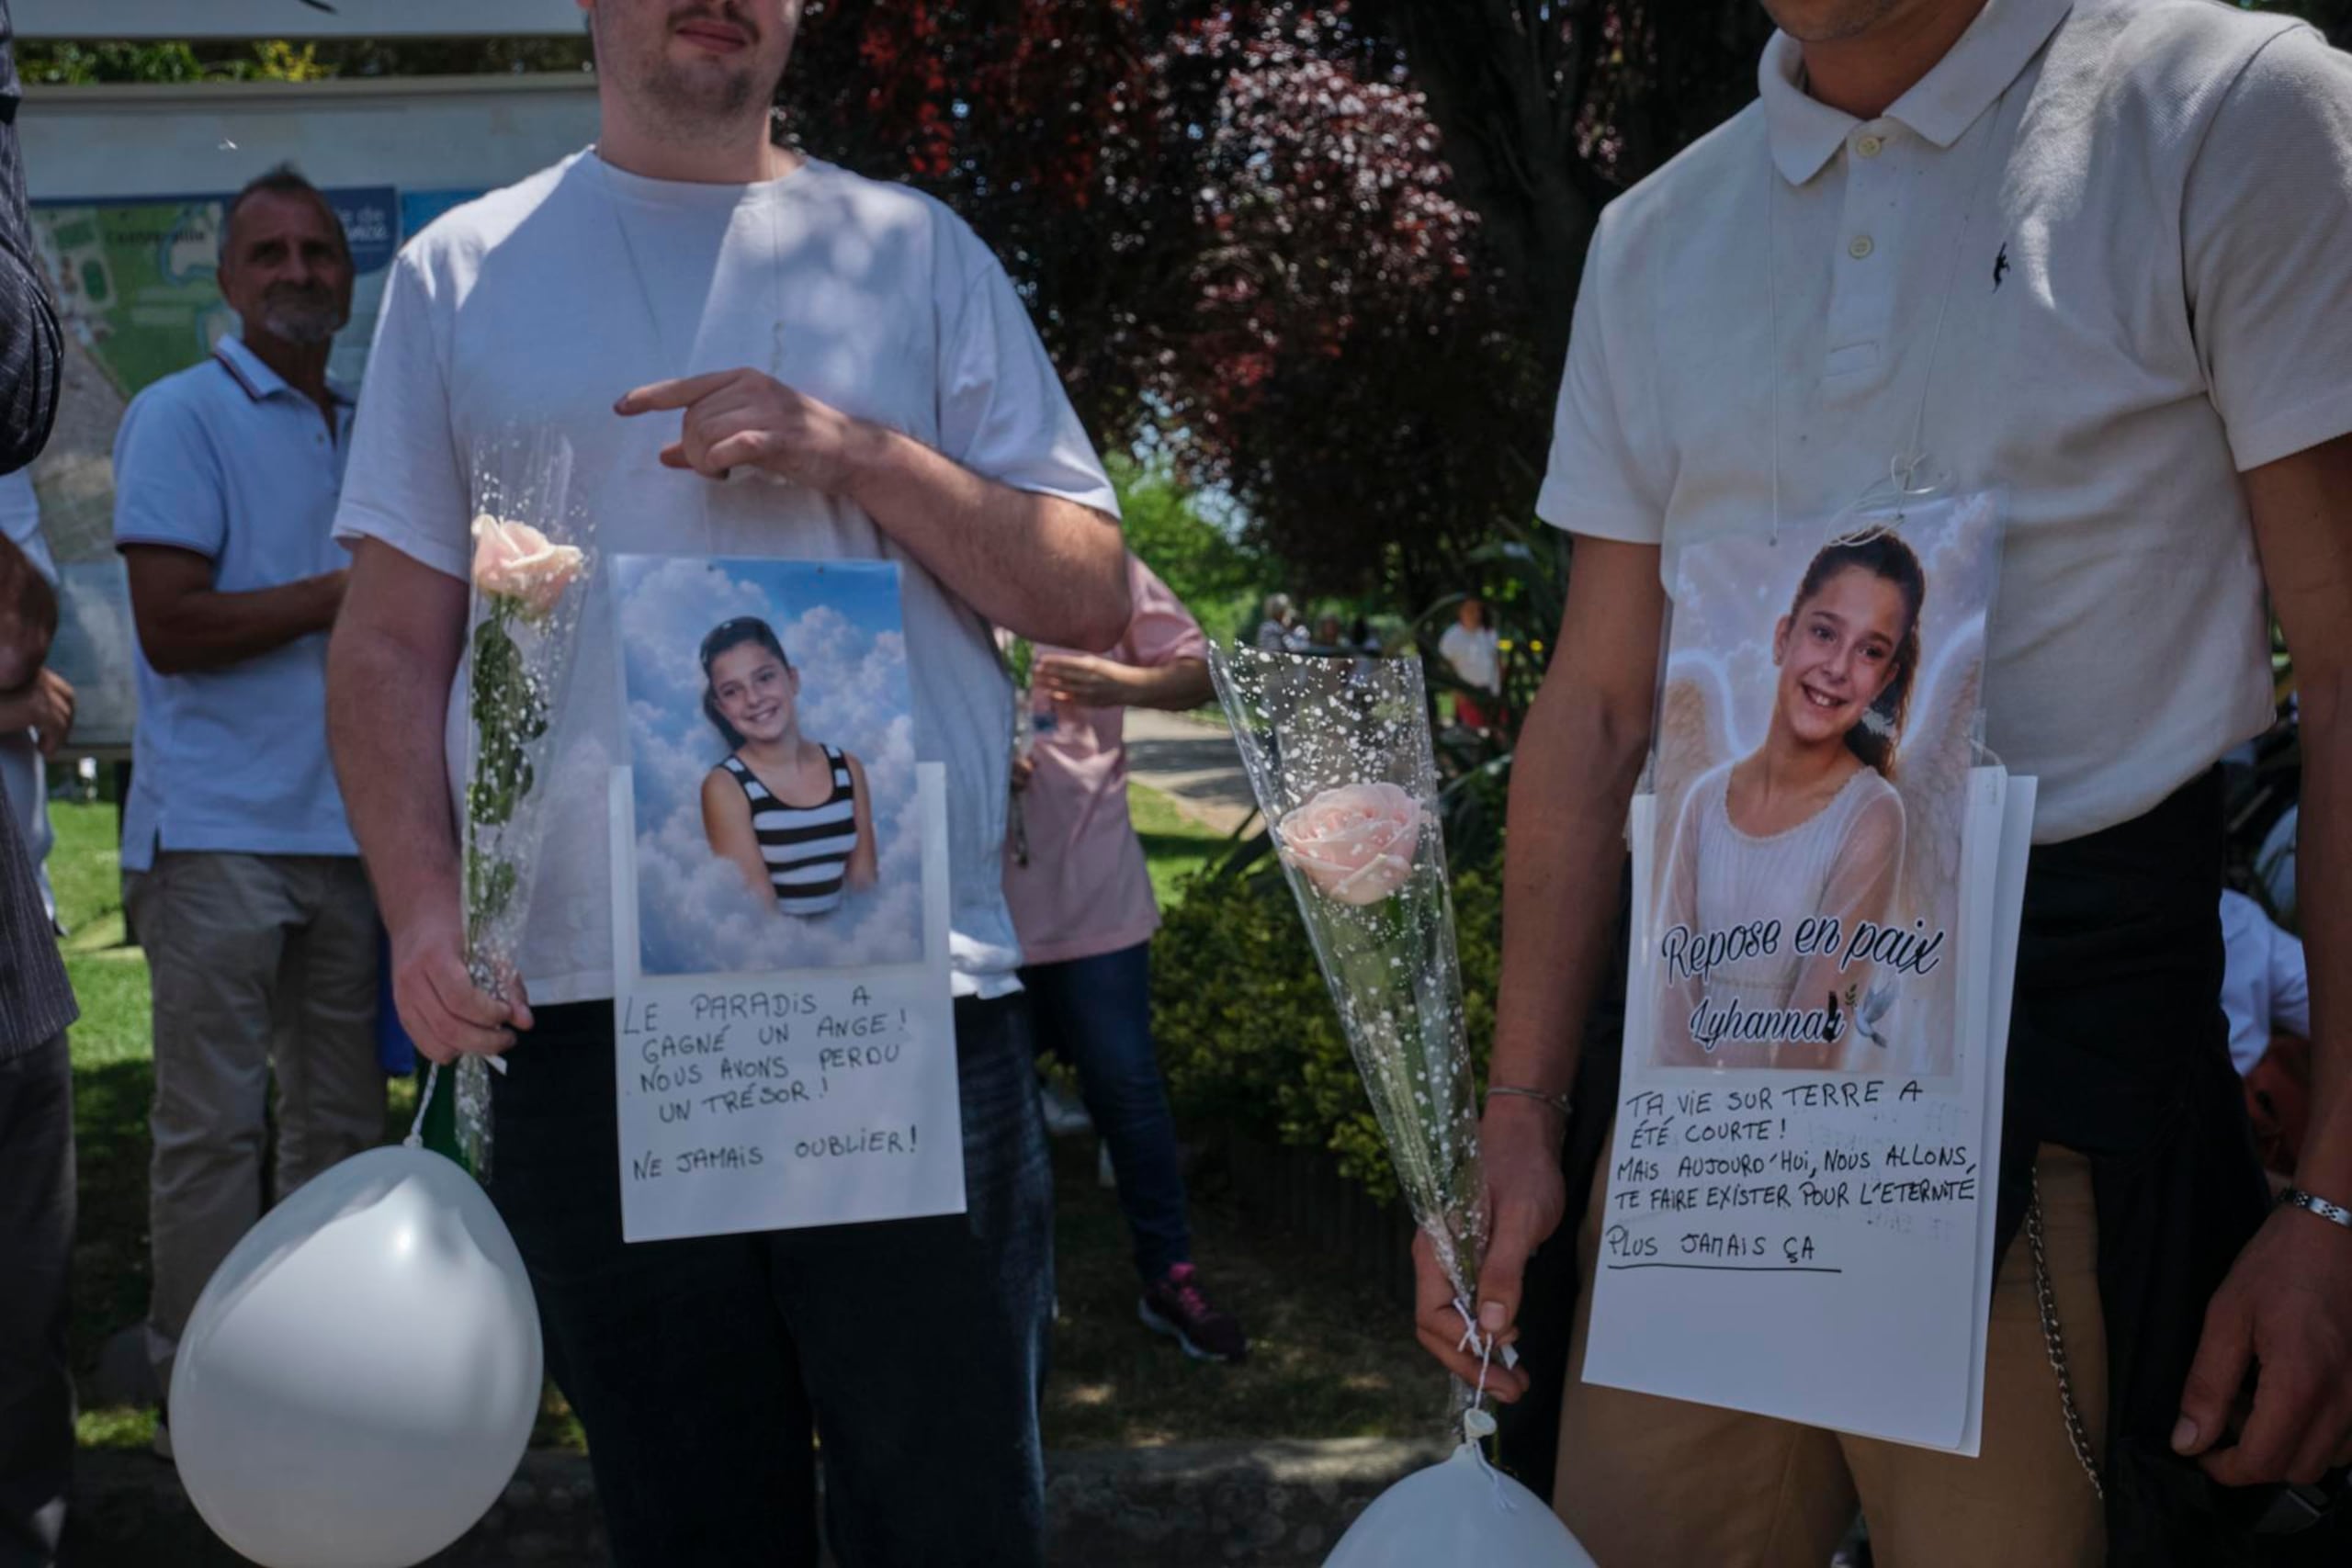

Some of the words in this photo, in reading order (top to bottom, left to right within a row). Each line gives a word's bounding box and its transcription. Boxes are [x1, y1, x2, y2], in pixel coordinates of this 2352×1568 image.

[1661, 919, 1781, 984] Repose
[1794, 917, 1840, 954] en
[1840, 919, 1944, 975] paix
[623, 995, 659, 1034] LE
[853, 986, 872, 1007] A
[642, 1024, 732, 1065] GAGNÉ
[758, 1022, 789, 1045] UN
[639, 1066, 703, 1093] NOUS
[719, 1055, 789, 1080] AVONS
[820, 1044, 901, 1071] PERDU
[659, 1100, 691, 1123] UN
[1625, 1089, 1665, 1119] TA
[1726, 1086, 1772, 1112] SUR
[1781, 1079, 1884, 1108] TERRE
[1898, 1079, 1924, 1102] A
[1631, 1116, 1675, 1150] ÉTÉ
[633, 1150, 662, 1180] NE
[1824, 1148, 1871, 1173] NOUS
[1613, 1190, 1641, 1211] TE
[1798, 1177, 1850, 1207] POUR
[1606, 1224, 1658, 1258] PLUS
[1781, 1235, 1815, 1264] ÇA
